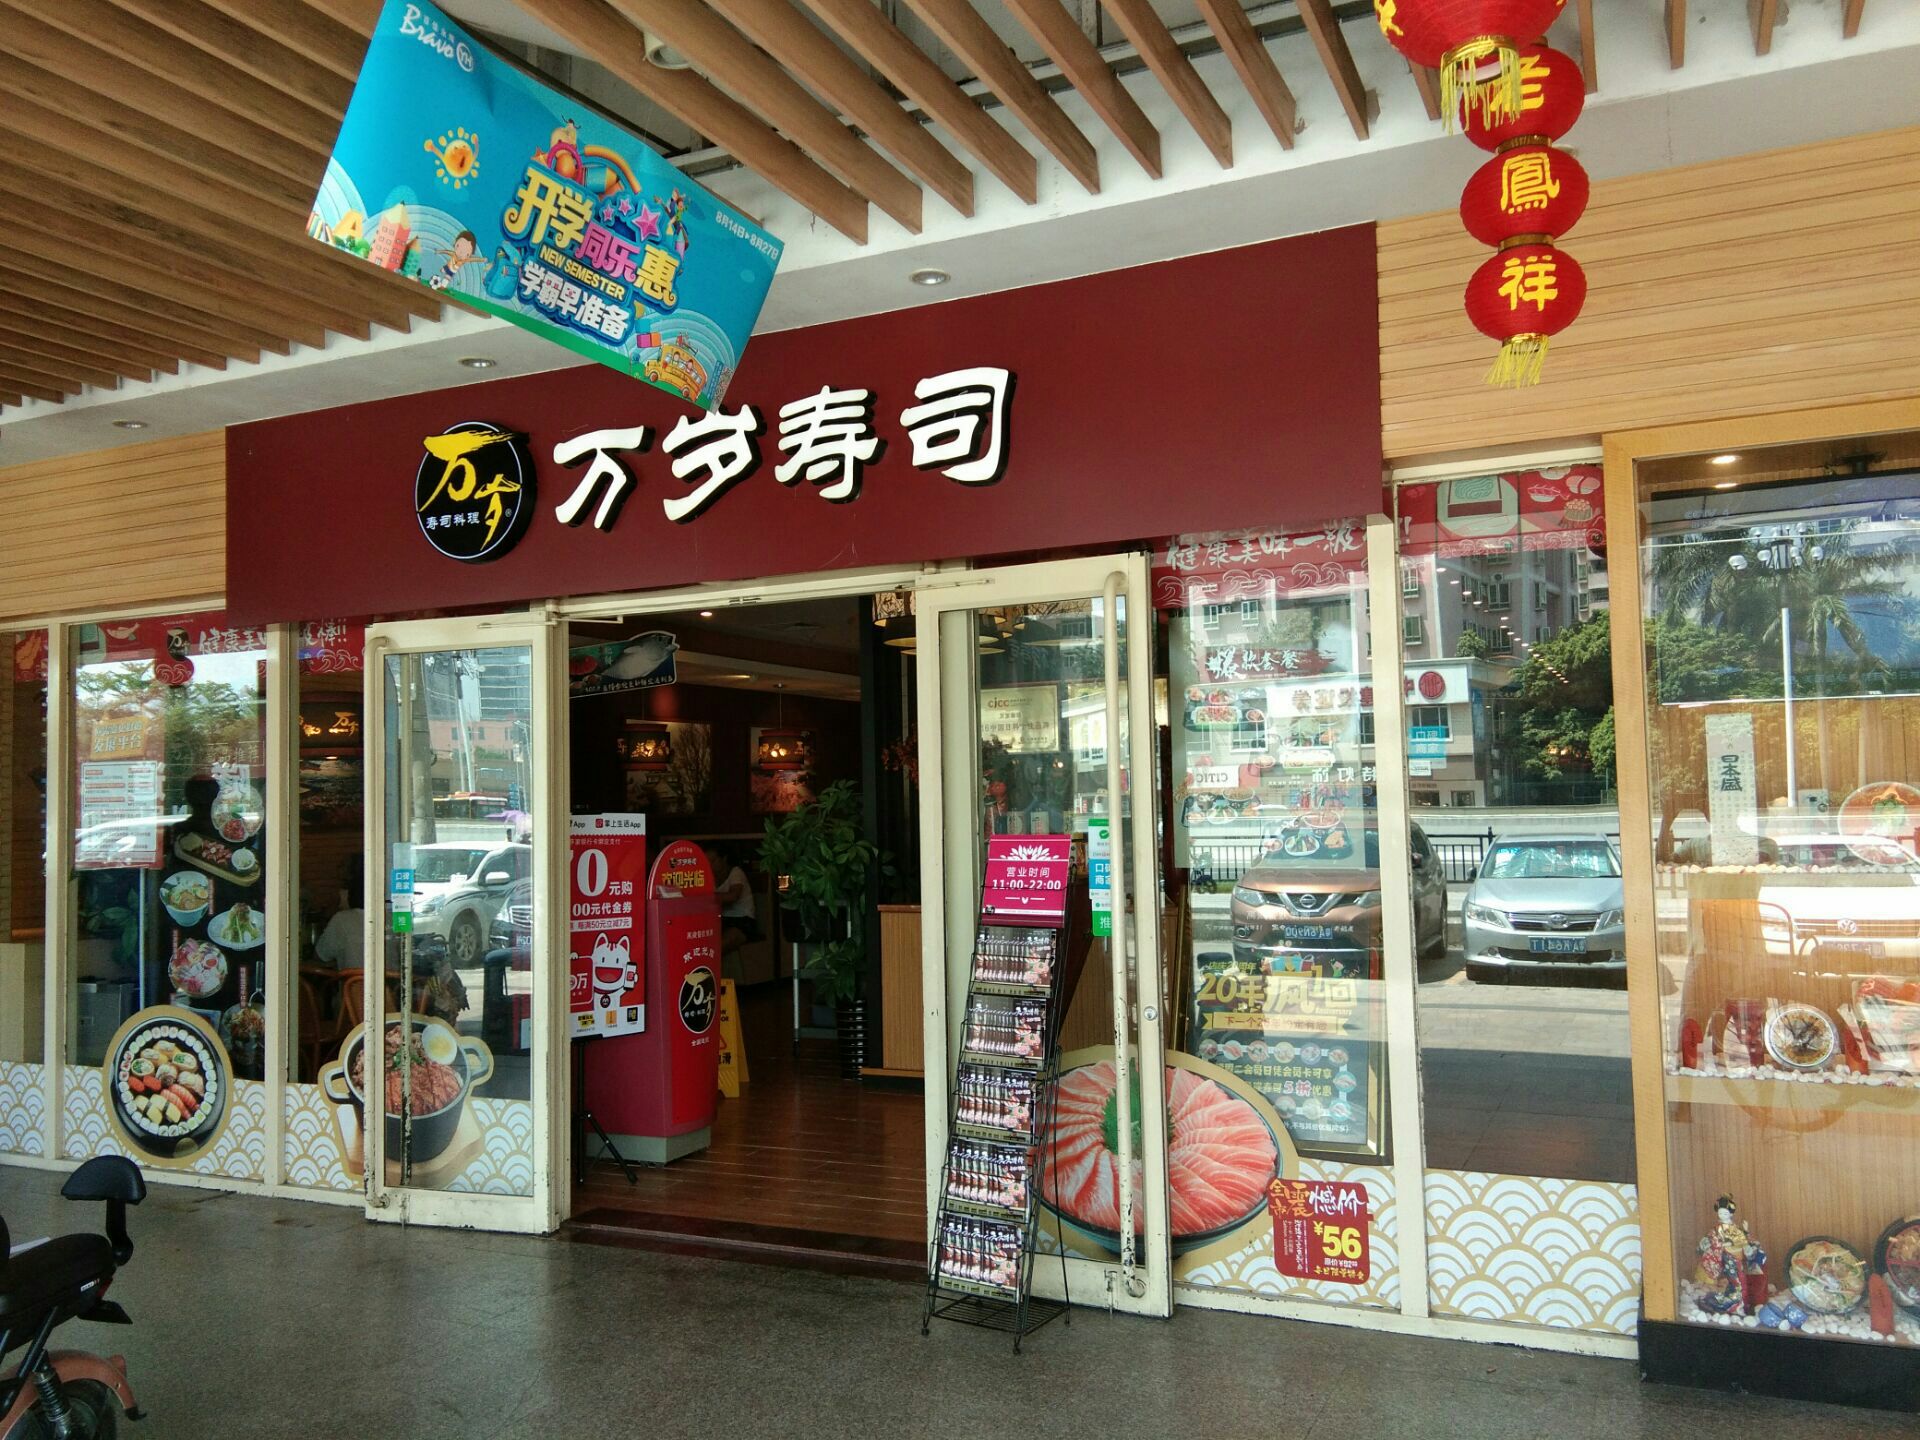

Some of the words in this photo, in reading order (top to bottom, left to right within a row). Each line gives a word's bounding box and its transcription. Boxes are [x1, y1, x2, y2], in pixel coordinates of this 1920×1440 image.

[399, 3, 454, 58] Bravo
[504, 167, 680, 306] 开学同乐惠
[539, 245, 566, 270] NEW
[564, 260, 625, 300] SEMESTER
[1498, 255, 1558, 312] 祥
[519, 260, 630, 341] 学霸早准备
[552, 366, 1010, 531] 万岁寿司
[426, 511, 480, 530] 寿司料理
[1720, 754, 1743, 792] 日本盛
[604, 819, 642, 829] 掌上生活App
[661, 869, 705, 889] 欢迎光临
[992, 879, 1062, 890] 11:00-22:00
[1006, 866, 1050, 878] 营业时间
